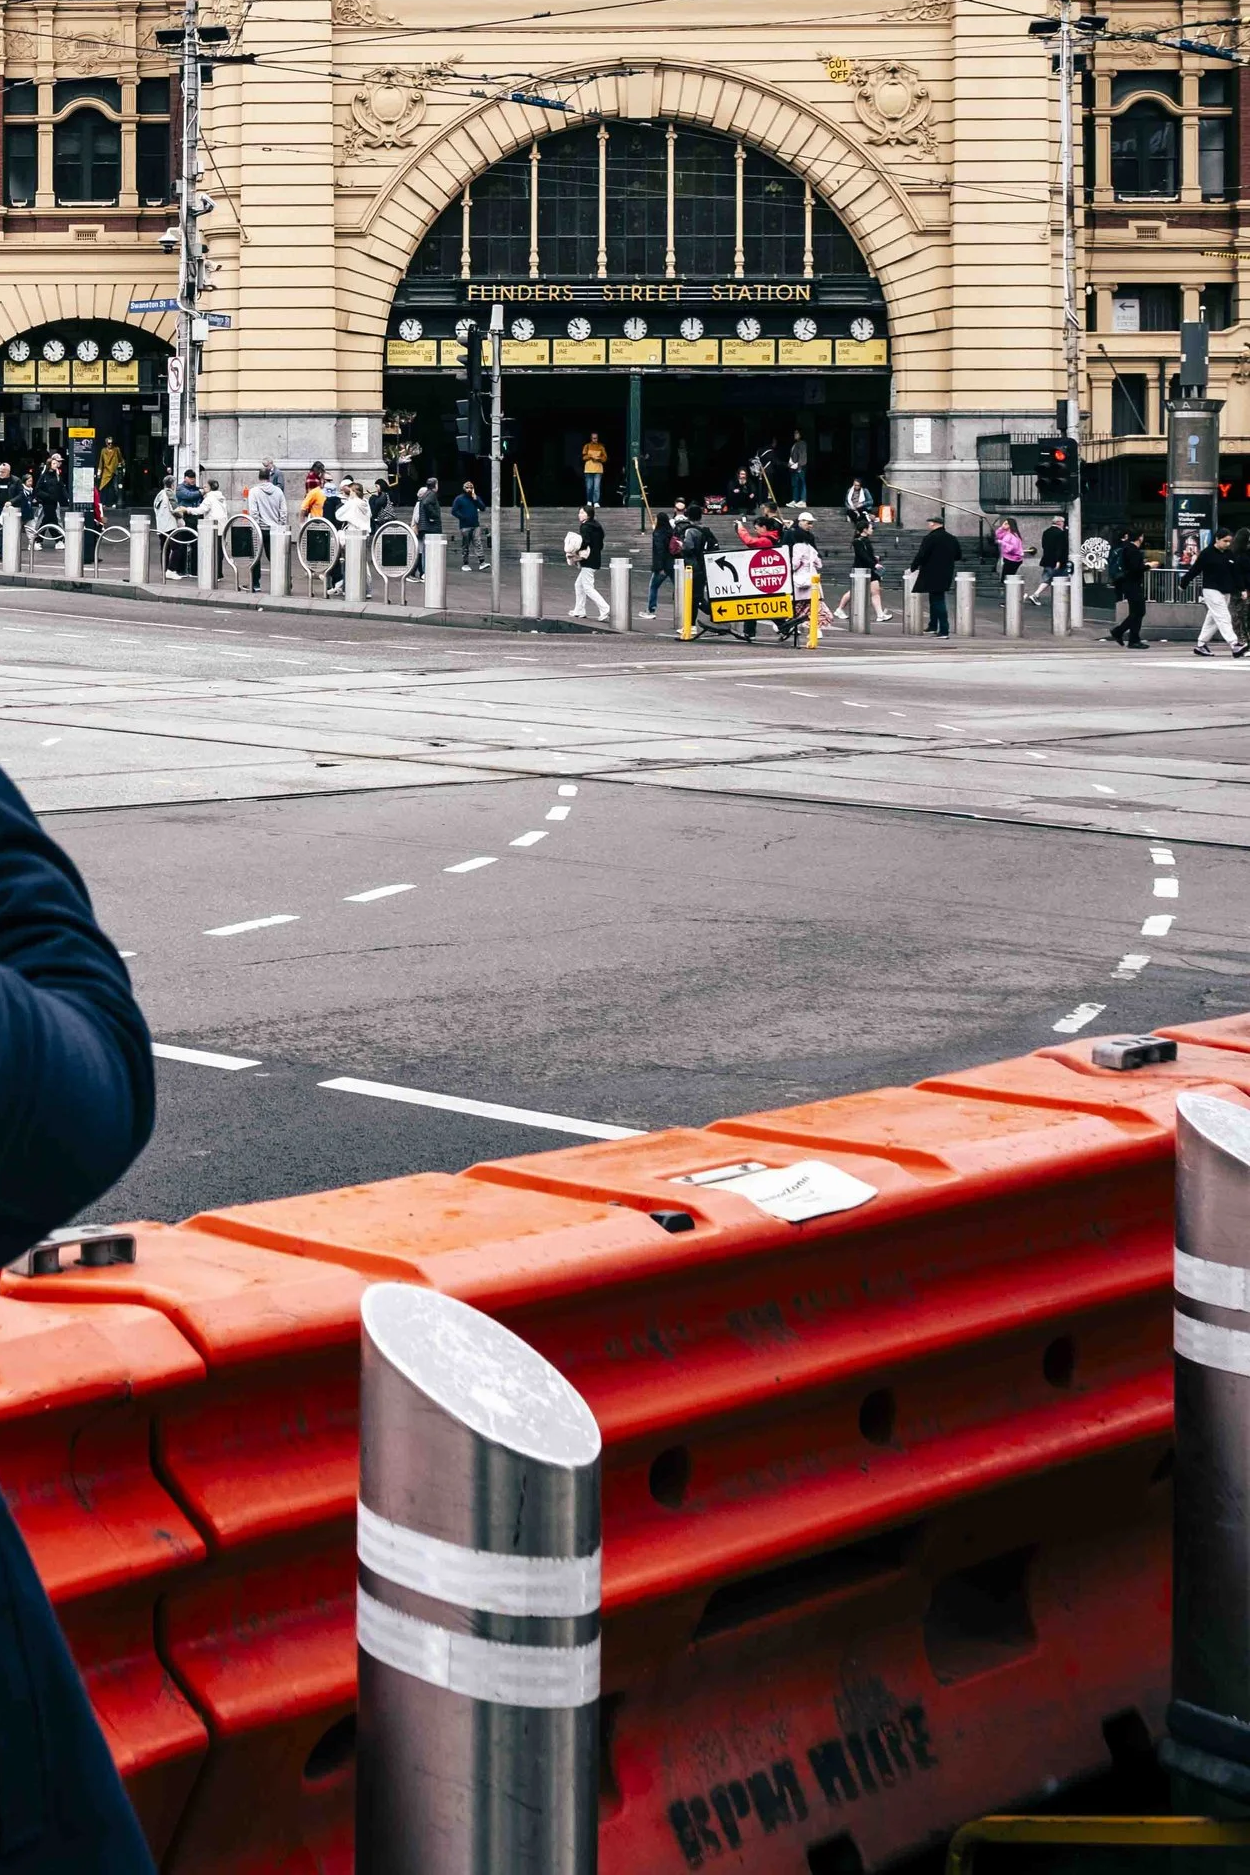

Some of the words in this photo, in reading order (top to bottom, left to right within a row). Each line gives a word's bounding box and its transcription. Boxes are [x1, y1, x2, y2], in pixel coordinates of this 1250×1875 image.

[468, 285, 573, 301] FLINDERS
[603, 285, 683, 301] STREET
[712, 285, 811, 301] STATION
[130, 302, 159, 310] Swanston
[159, 300, 166, 308] St
[761, 556, 774, 565] NO
[755, 576, 784, 587] ENTRY
[715, 585, 742, 595] ONLY
[737, 601, 789, 615] DETOUR
[669, 1756, 809, 1870] RPM
